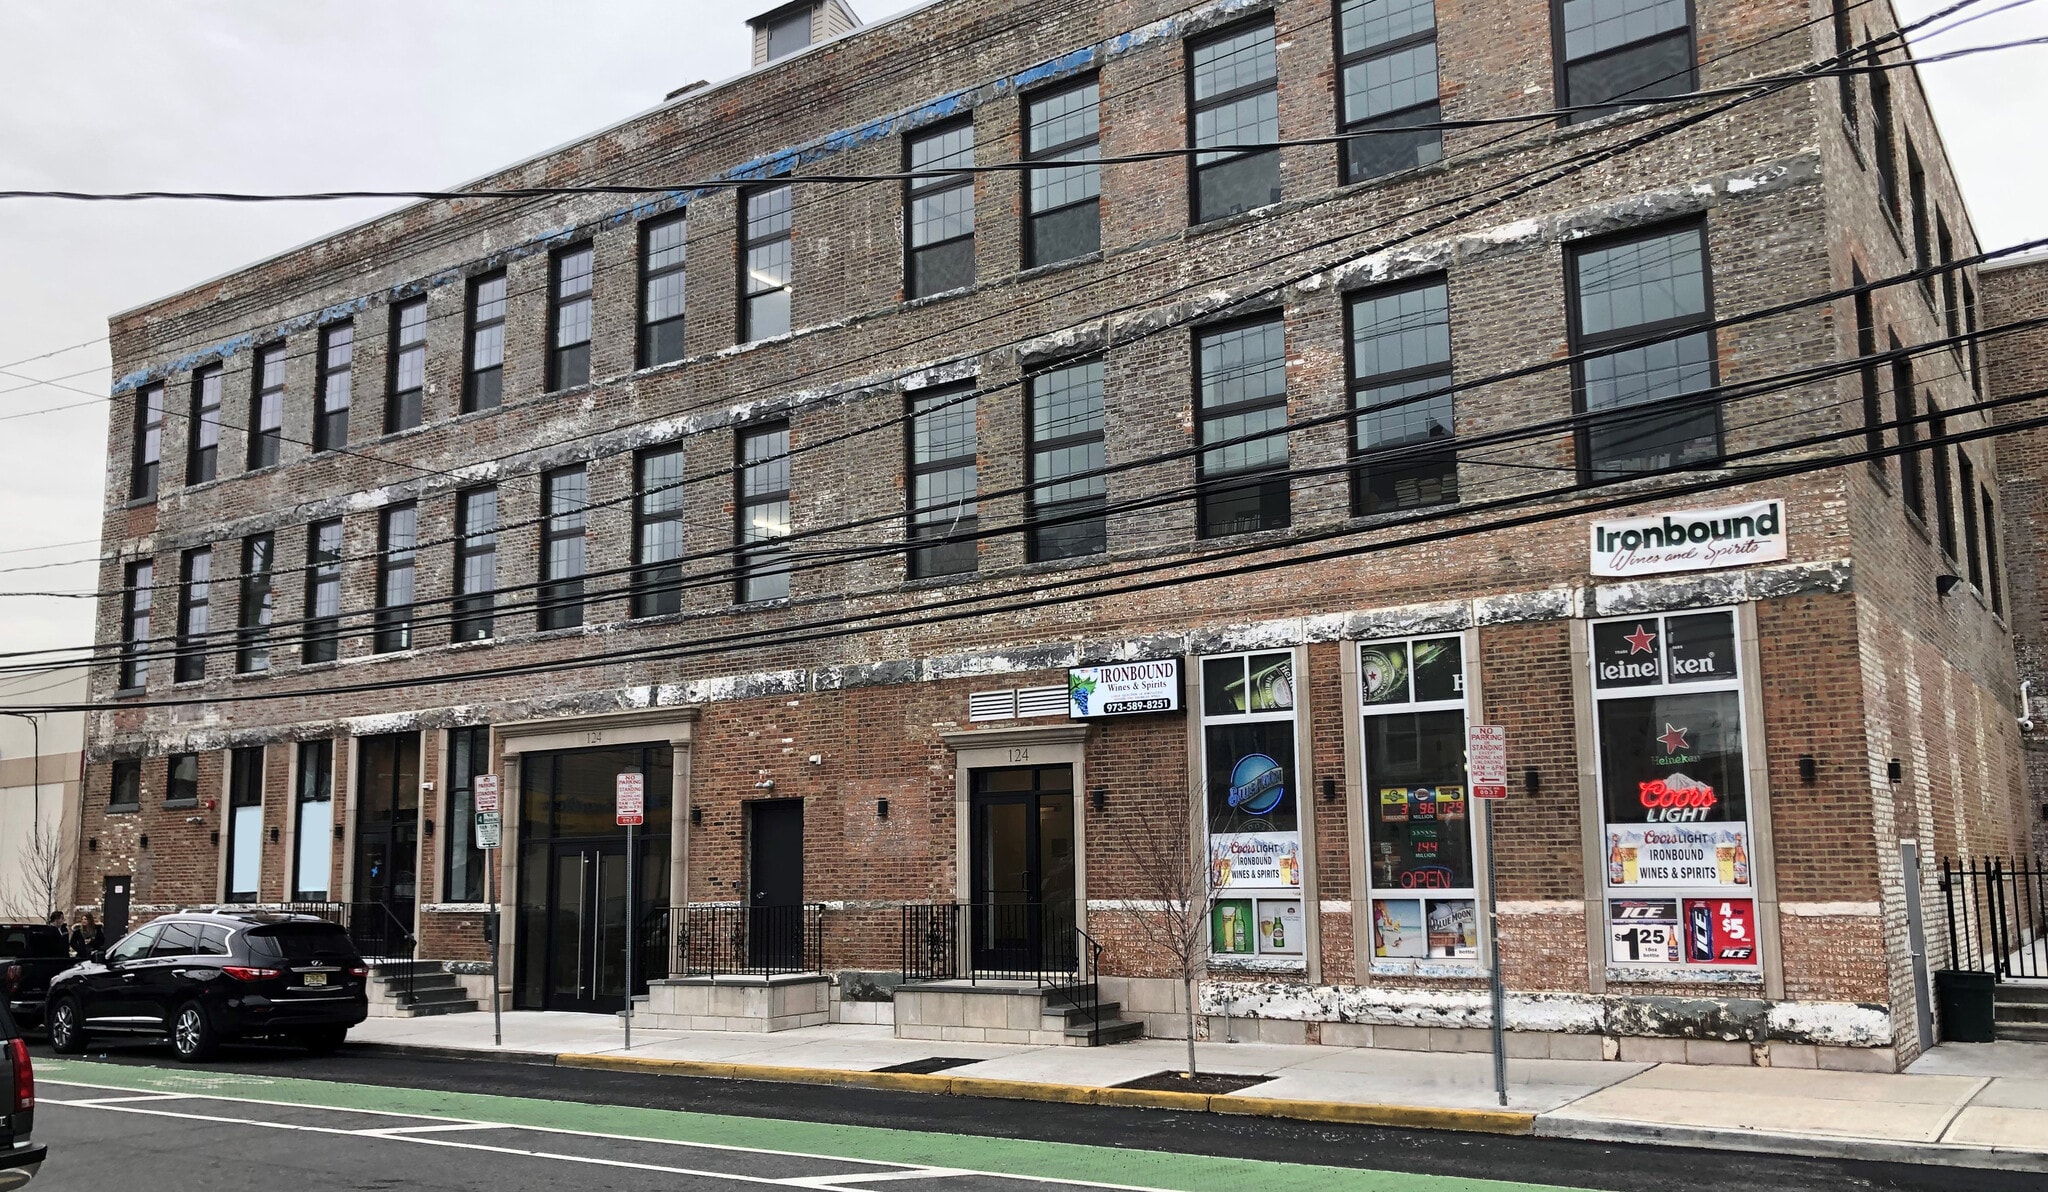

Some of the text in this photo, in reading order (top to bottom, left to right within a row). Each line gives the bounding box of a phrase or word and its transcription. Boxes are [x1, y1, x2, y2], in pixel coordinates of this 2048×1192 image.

[1596, 503, 1779, 553] Ironbound
[1609, 537, 1771, 571] Wines and Spirits
[1100, 662, 1174, 683] IRONBOUND
[1107, 681, 1167, 692] Wines & Spirits
[1106, 699, 1169, 712] 973-589-8251
[587, 731, 602, 744] 124
[1008, 748, 1029, 762] 124
[1651, 754, 1700, 765] Heineken
[1639, 779, 1717, 808] Coors
[1401, 804, 1408, 815] 3
[1420, 802, 1436, 815] 96
[1646, 807, 1711, 823] LIGHT
[1644, 830, 1708, 845] Coors LIGHT
[1230, 841, 1279, 854] Coors LIGHT
[1417, 841, 1438, 853] 144
[1237, 855, 1273, 866] IRONBOUND
[1649, 848, 1704, 861] IRONBOUND
[1231, 869, 1280, 879] WINES & SPIRITS
[1401, 869, 1451, 889] OPEN
[1640, 866, 1717, 879] WINES & SPIRITS
[1620, 906, 1665, 918] ICE
[1719, 902, 1732, 918] 4
[1430, 909, 1474, 931] BLUE MOON
[1694, 910, 1709, 954] ICE
[1722, 918, 1746, 940] $5
[1721, 949, 1751, 958] ICE
